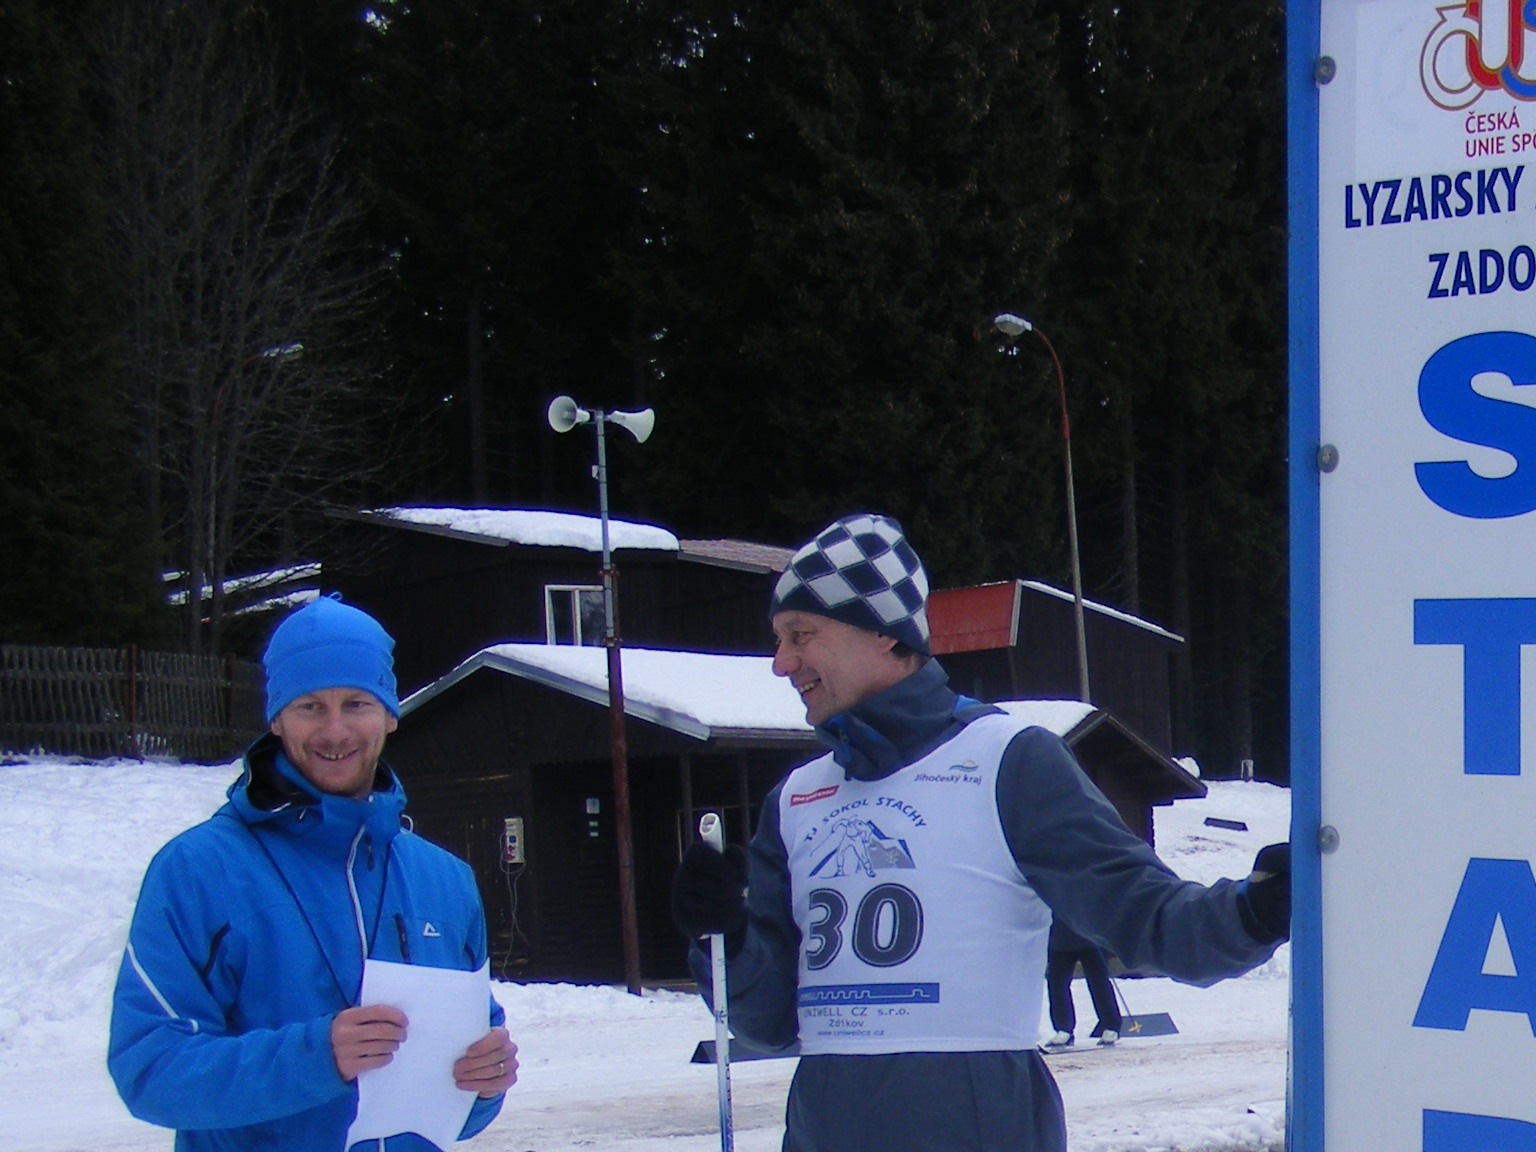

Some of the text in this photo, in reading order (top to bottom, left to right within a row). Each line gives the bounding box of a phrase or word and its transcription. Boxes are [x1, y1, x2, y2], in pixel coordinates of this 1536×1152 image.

[1465, 106, 1520, 134] ČESKÁ
[1465, 136, 1506, 158] UNIE
[913, 773, 982, 786] Jihočeský kraj
[822, 798, 869, 824] SOKOL
[875, 796, 927, 828] STACHY
[805, 882, 925, 971] 30
[851, 1006, 868, 1017] CZ
[877, 1008, 910, 1016] s.r.o.
